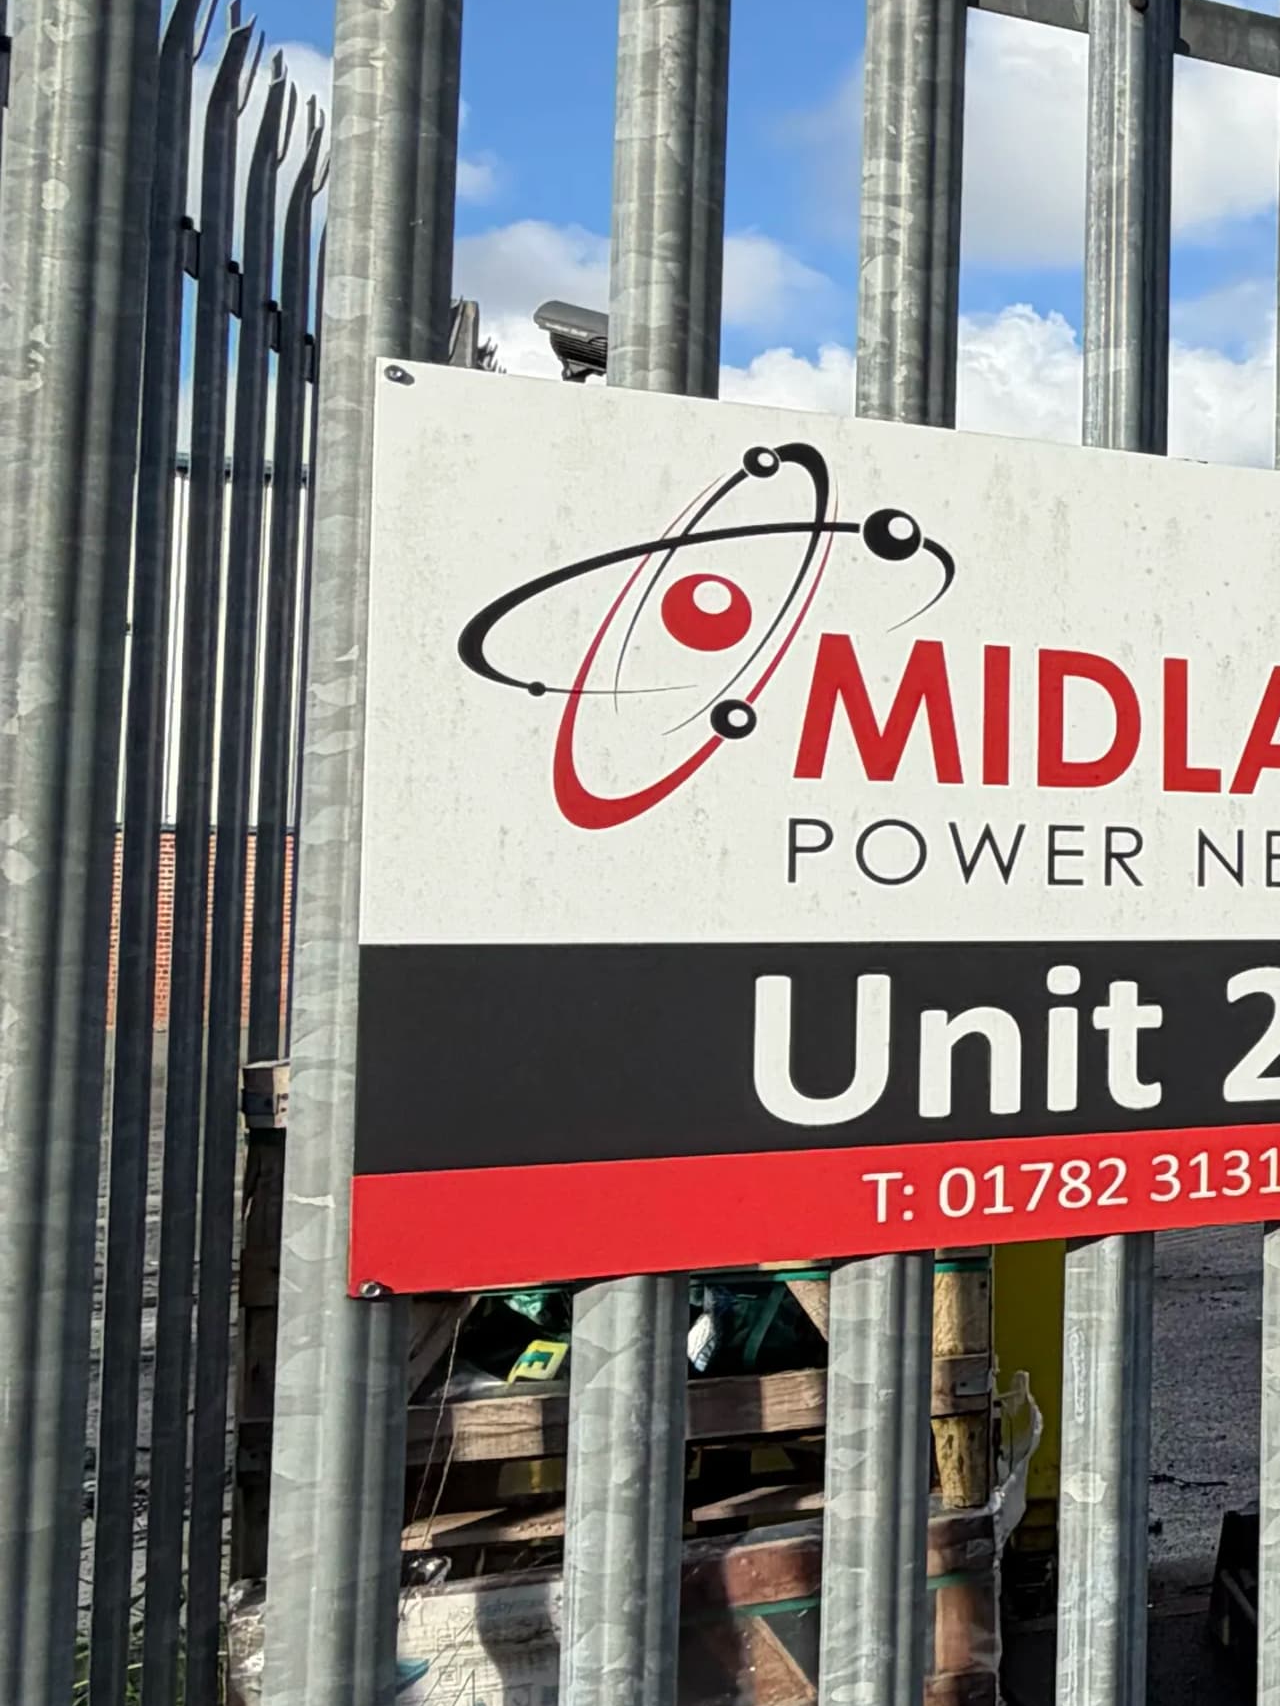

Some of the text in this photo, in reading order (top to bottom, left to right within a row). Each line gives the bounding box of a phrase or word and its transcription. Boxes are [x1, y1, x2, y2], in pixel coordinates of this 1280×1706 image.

[787, 817, 1144, 887] POWER
[753, 965, 1164, 1126] Unit
[862, 1172, 915, 1224] T:
[938, 1157, 1129, 1219] 01782
